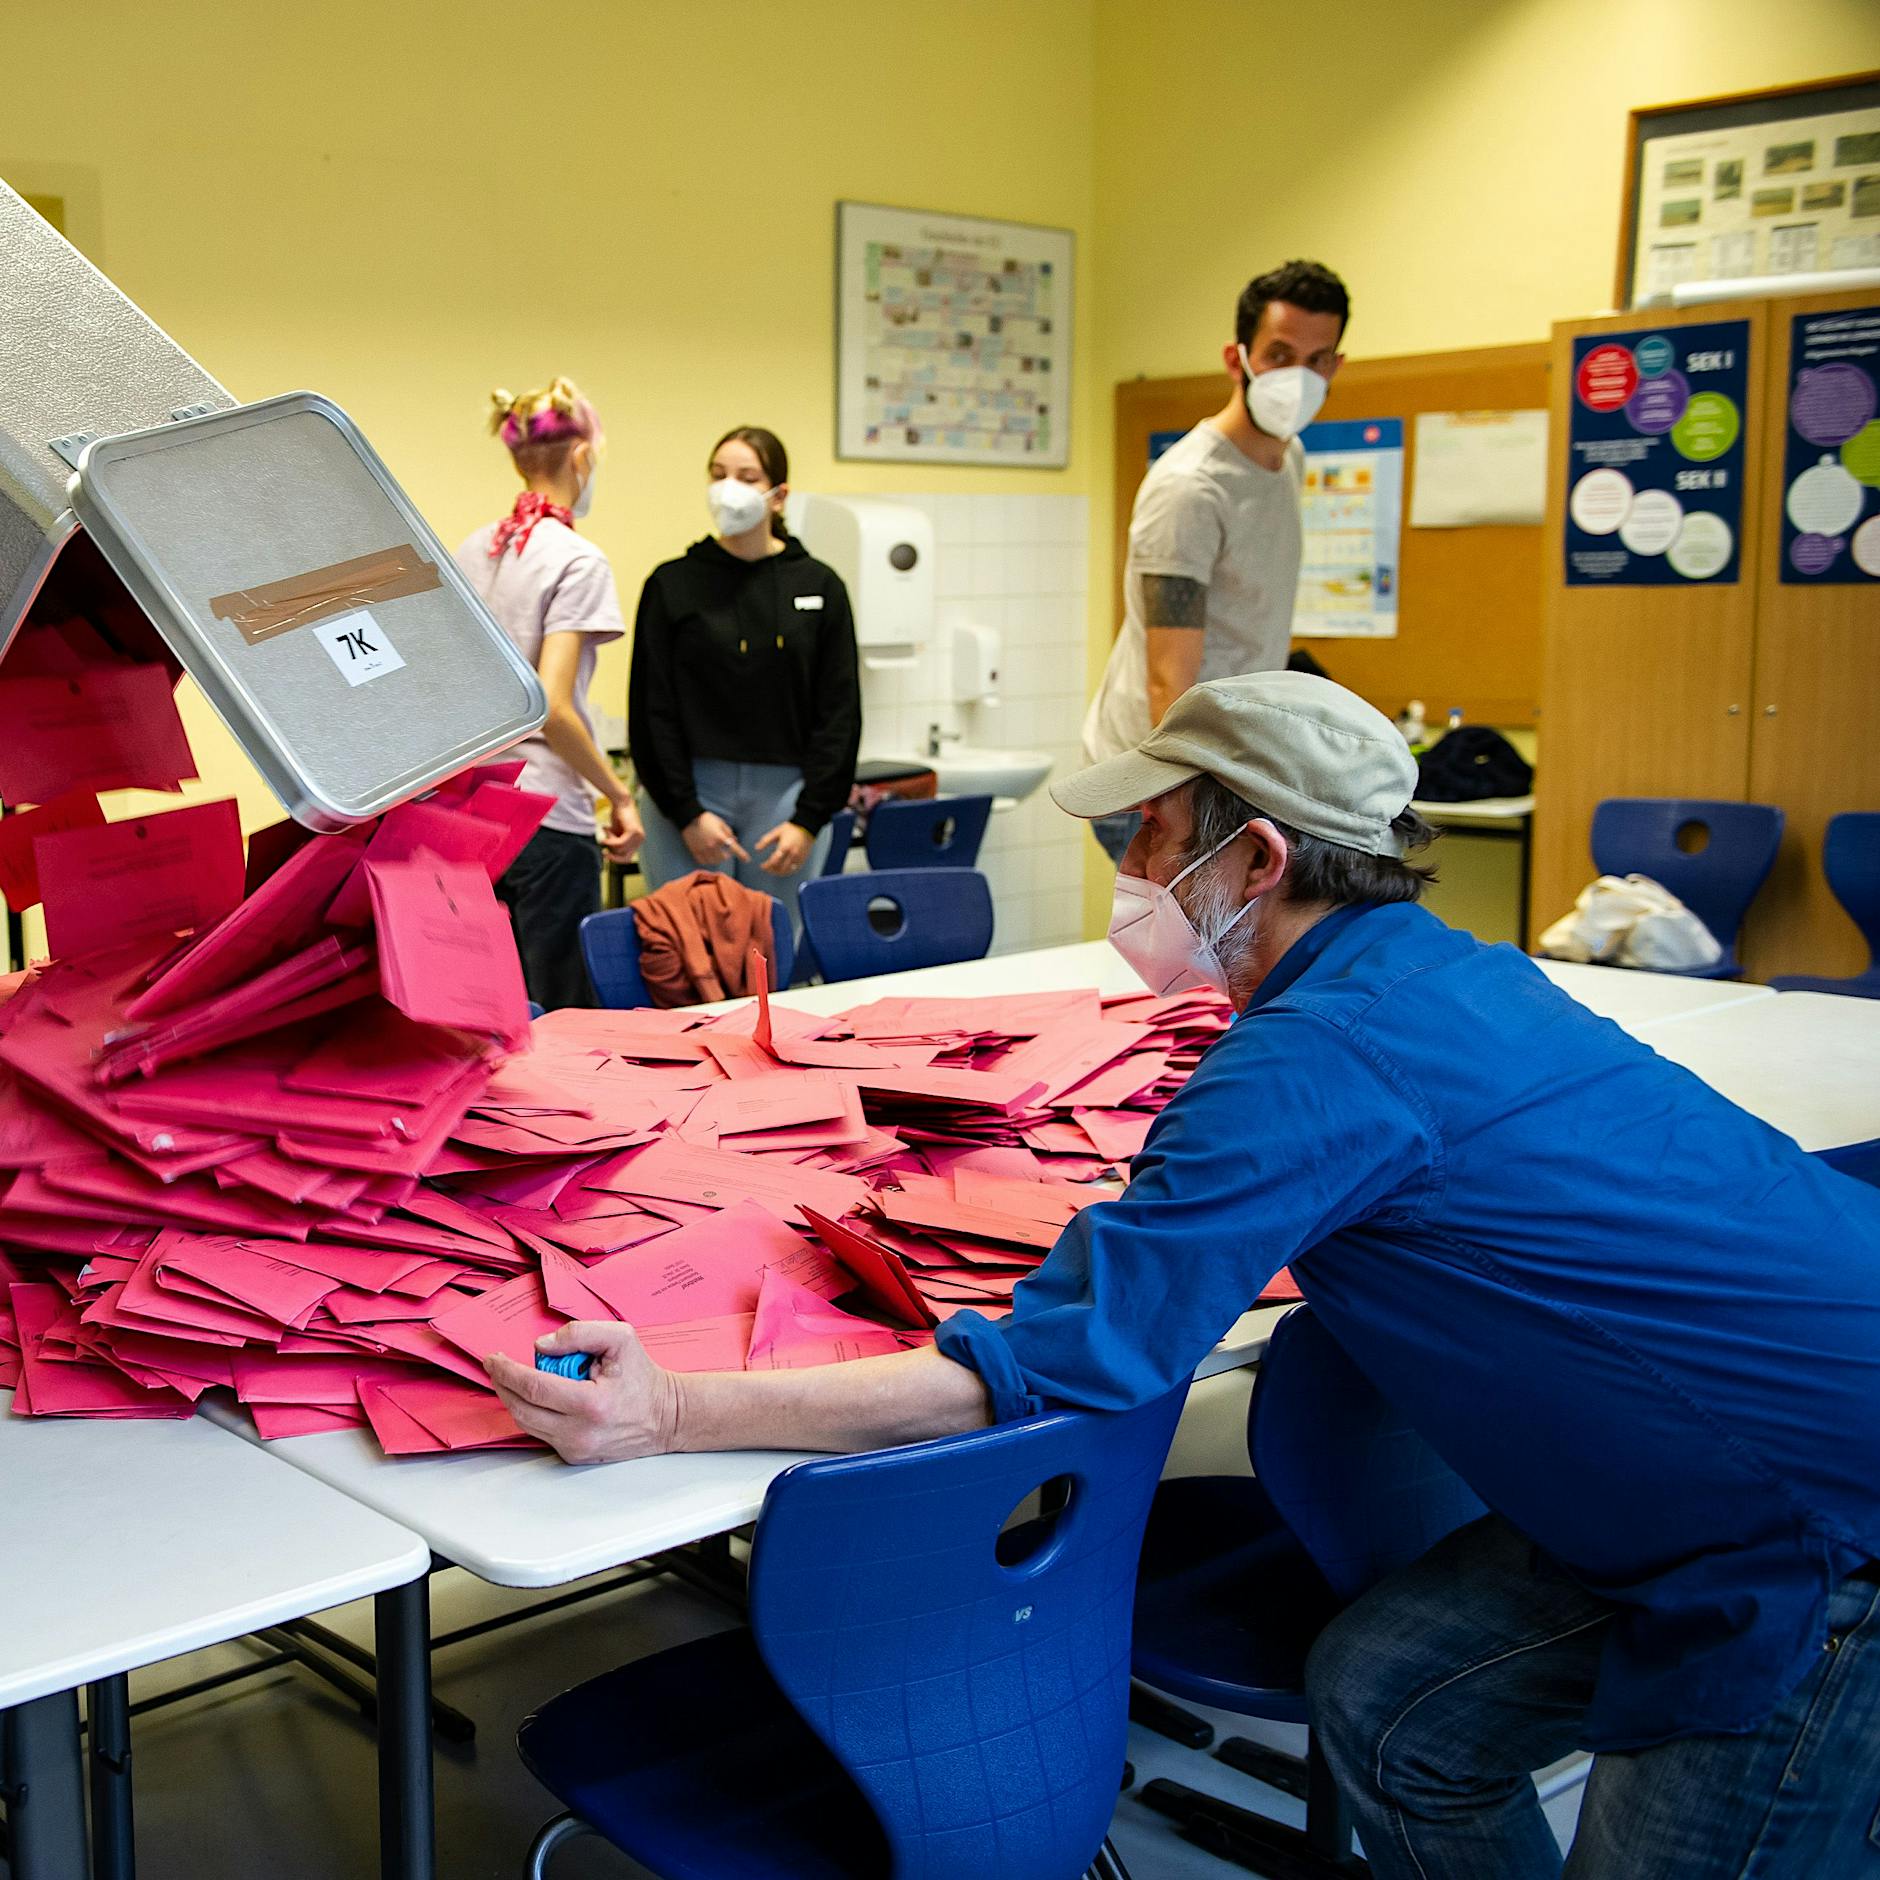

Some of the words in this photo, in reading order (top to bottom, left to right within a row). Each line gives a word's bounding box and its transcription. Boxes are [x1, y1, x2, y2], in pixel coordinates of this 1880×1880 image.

[1686, 351, 1722, 372] SEK
[1725, 350, 1733, 369] I
[1675, 470, 1711, 490] SEK
[336, 628, 378, 660] 7K
[1015, 1605, 1033, 1622] VS
